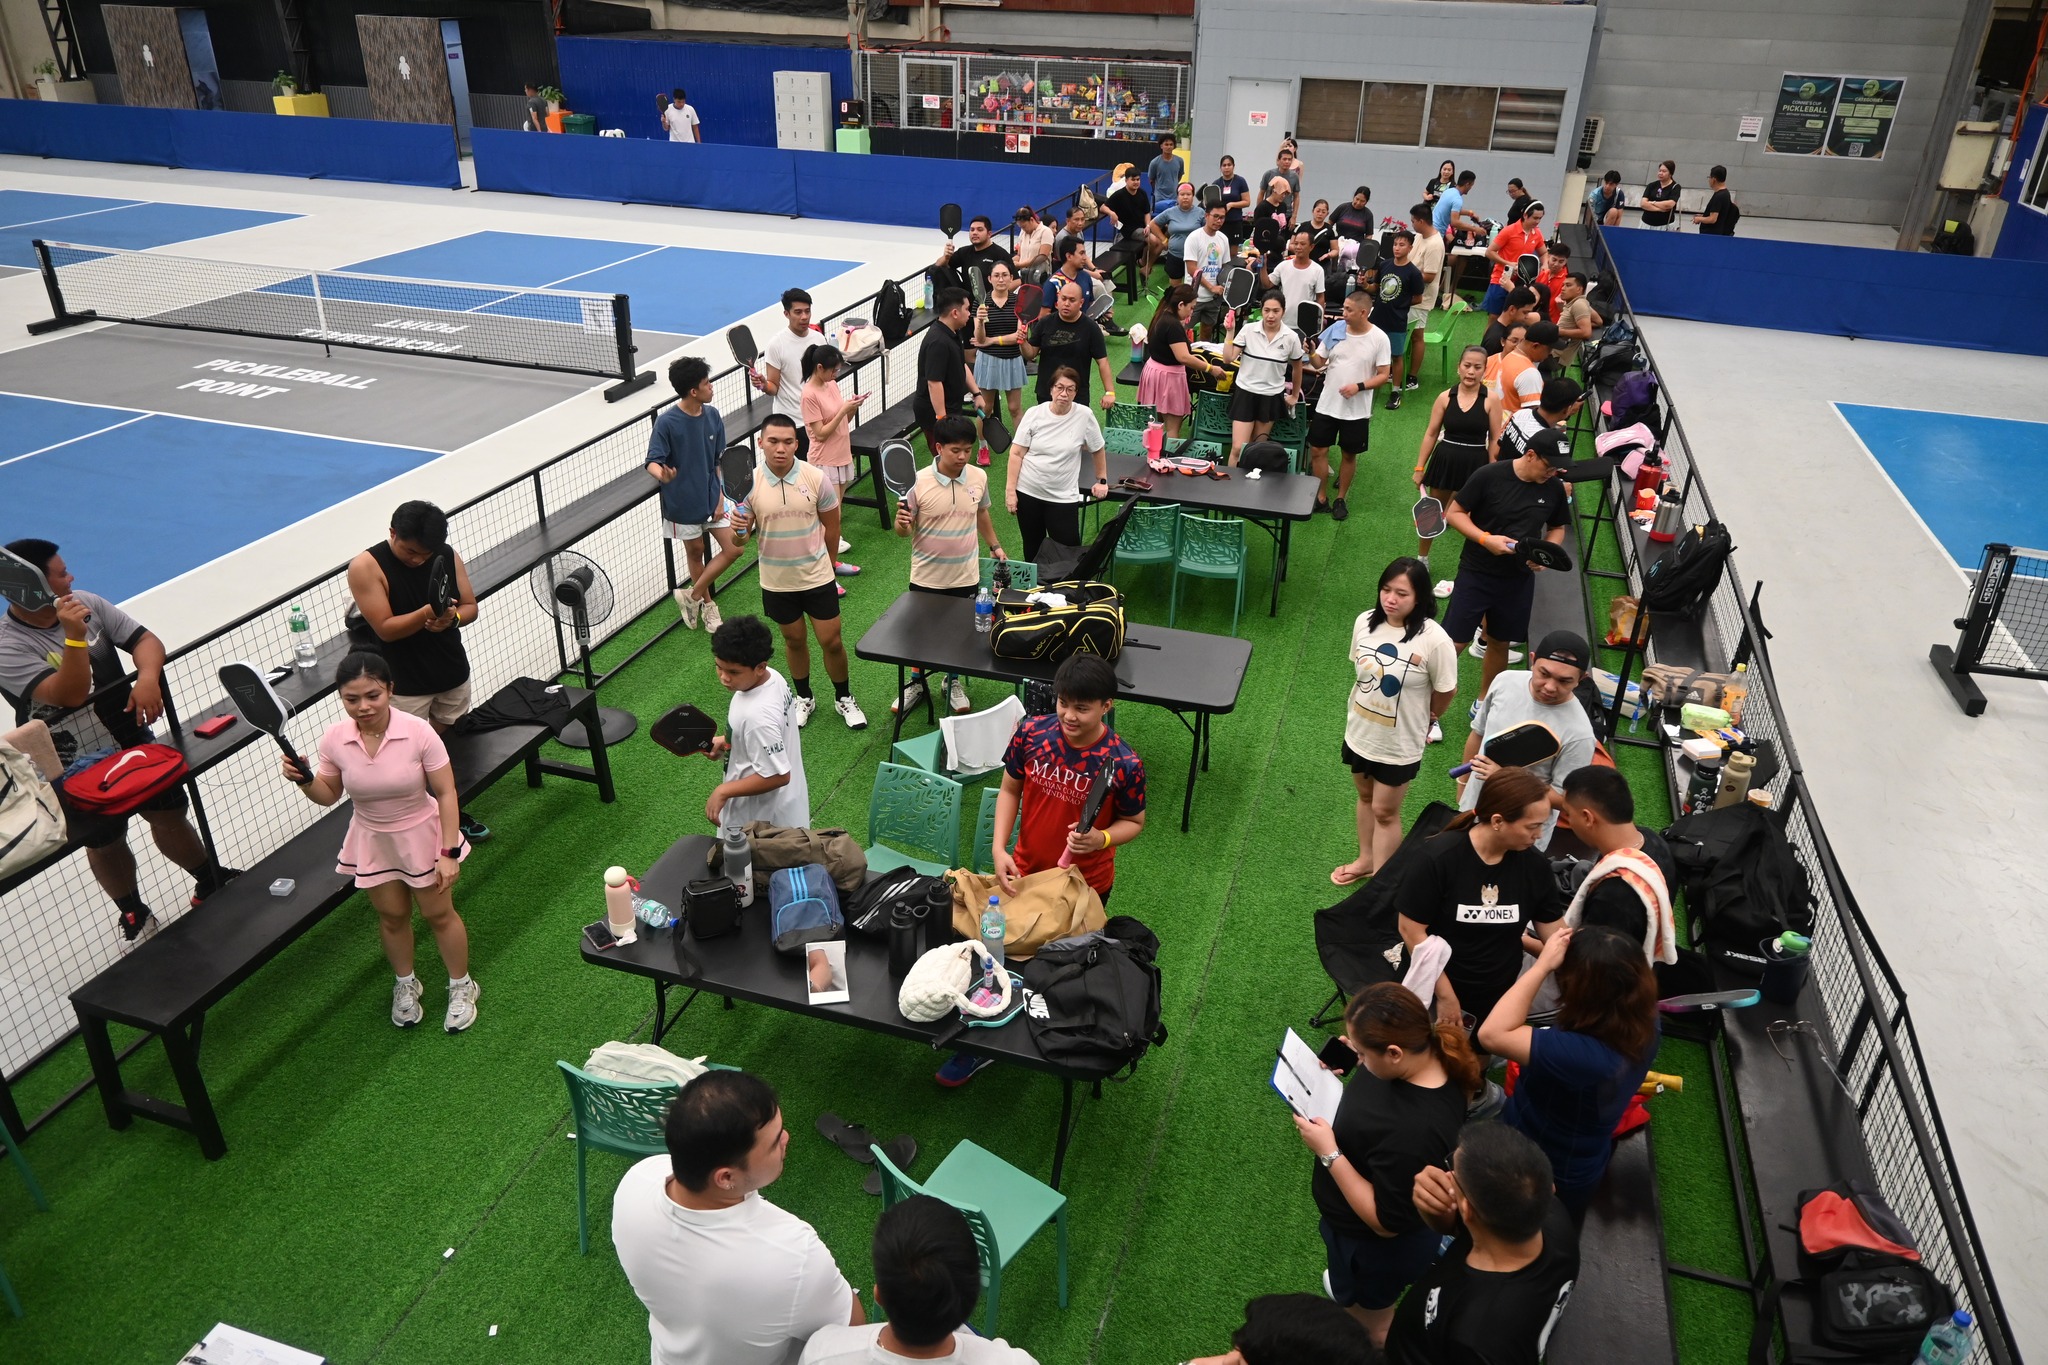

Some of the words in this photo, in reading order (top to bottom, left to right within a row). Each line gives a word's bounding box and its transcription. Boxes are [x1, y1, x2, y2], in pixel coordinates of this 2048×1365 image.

[1782, 104, 1828, 114] PICKLEBALL
[193, 358, 378, 390] PICKLEBALL
[177, 378, 291, 399] POINT
[1983, 578, 1998, 602] SPORT
[1030, 759, 1092, 794] MAPÚ
[1030, 775, 1062, 791] MALAYAN
[1041, 786, 1081, 806] MINDANAO
[1484, 909, 1514, 920] YONEX
